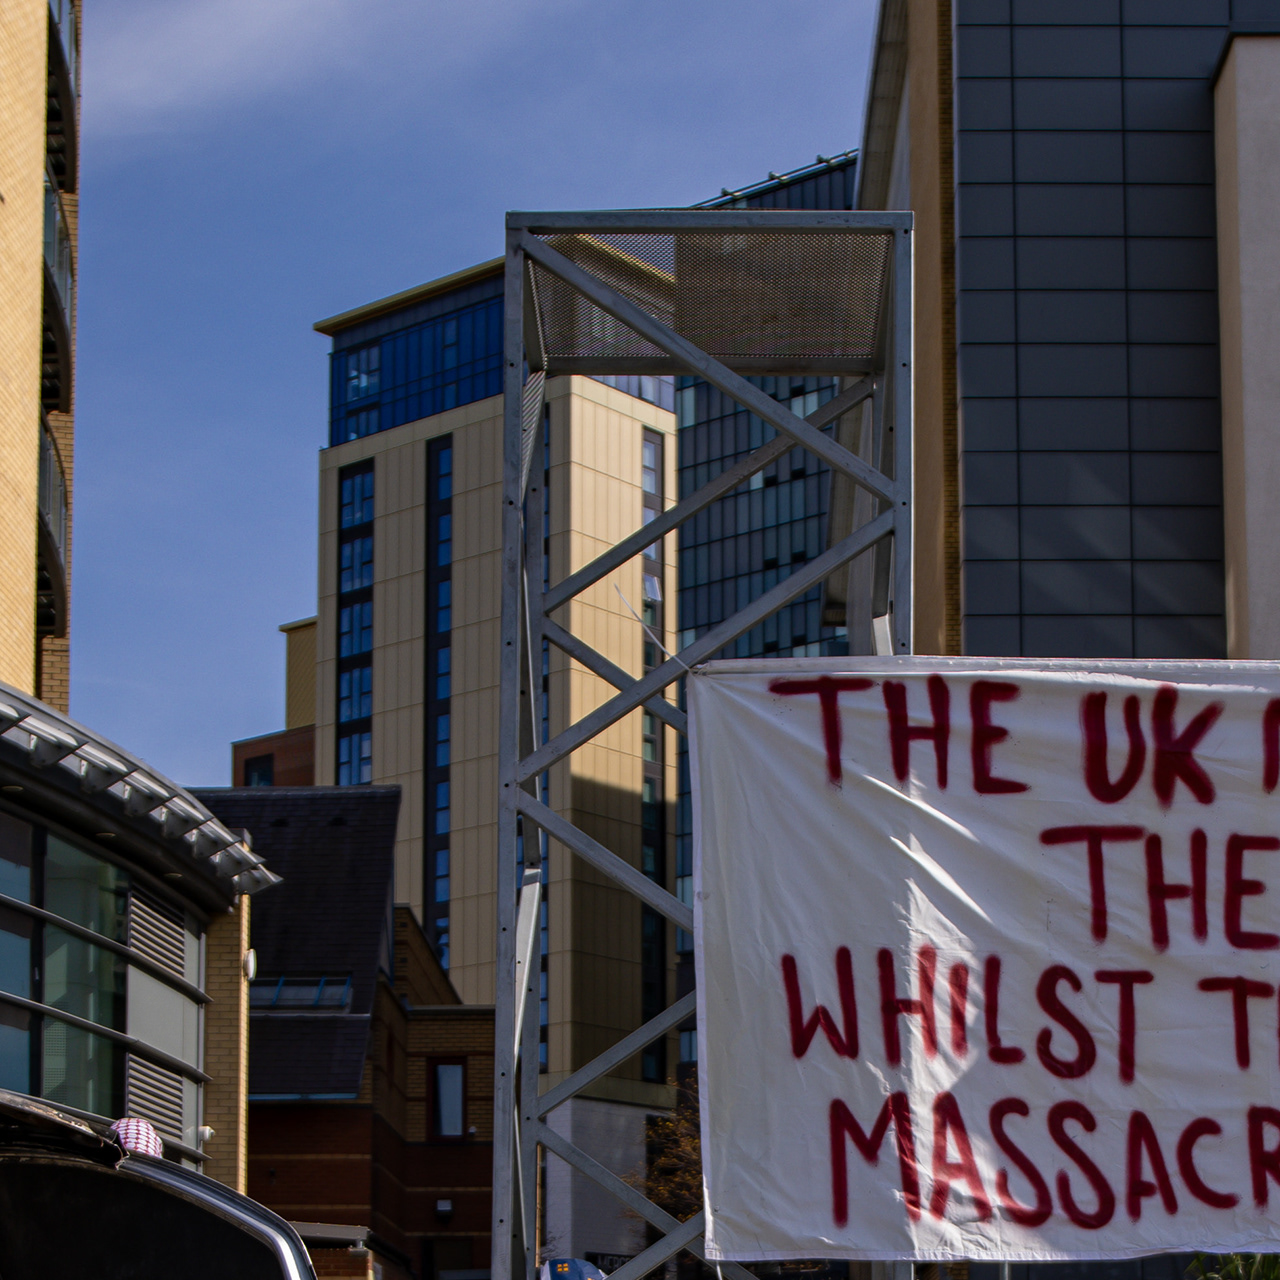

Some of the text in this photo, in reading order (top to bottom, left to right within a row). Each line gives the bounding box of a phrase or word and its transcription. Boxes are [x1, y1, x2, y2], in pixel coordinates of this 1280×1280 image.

[770, 674, 1031, 794] THE
[1079, 685, 1223, 807] UK
[779, 944, 1154, 1085] WHILST
